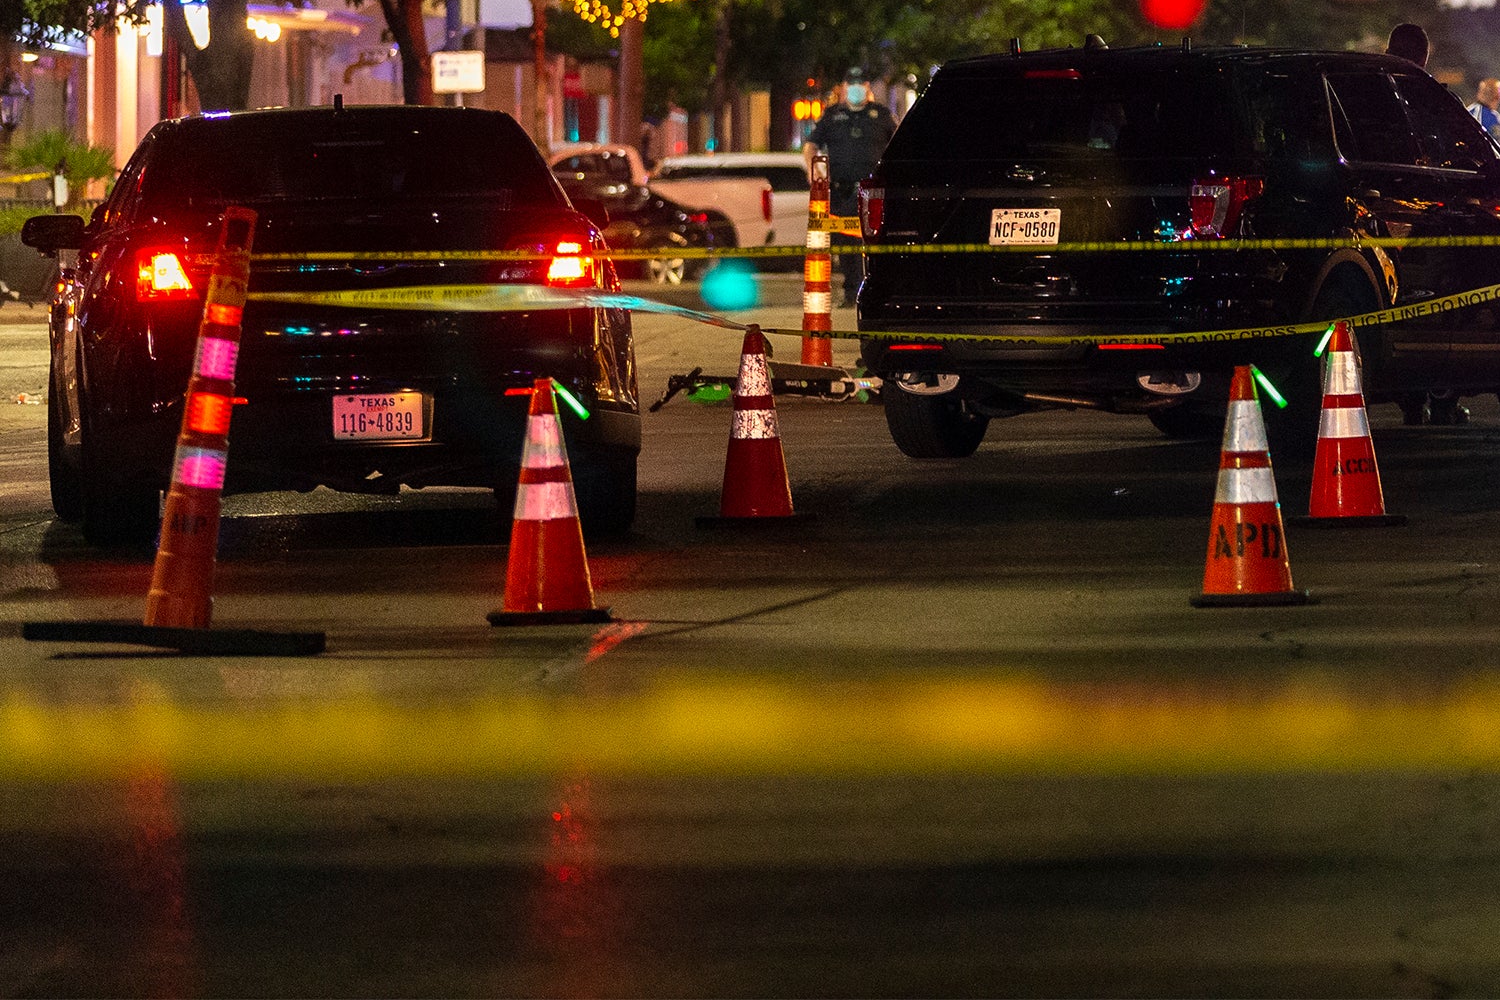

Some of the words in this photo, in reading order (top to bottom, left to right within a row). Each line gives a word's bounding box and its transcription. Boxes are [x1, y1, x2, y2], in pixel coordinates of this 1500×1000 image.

[1391, 305, 1426, 321] LINE
[1431, 300, 1454, 313] DO
[1457, 290, 1490, 307] NOT
[360, 398, 395, 407] TEXAS
[1214, 523, 1282, 559] APD
